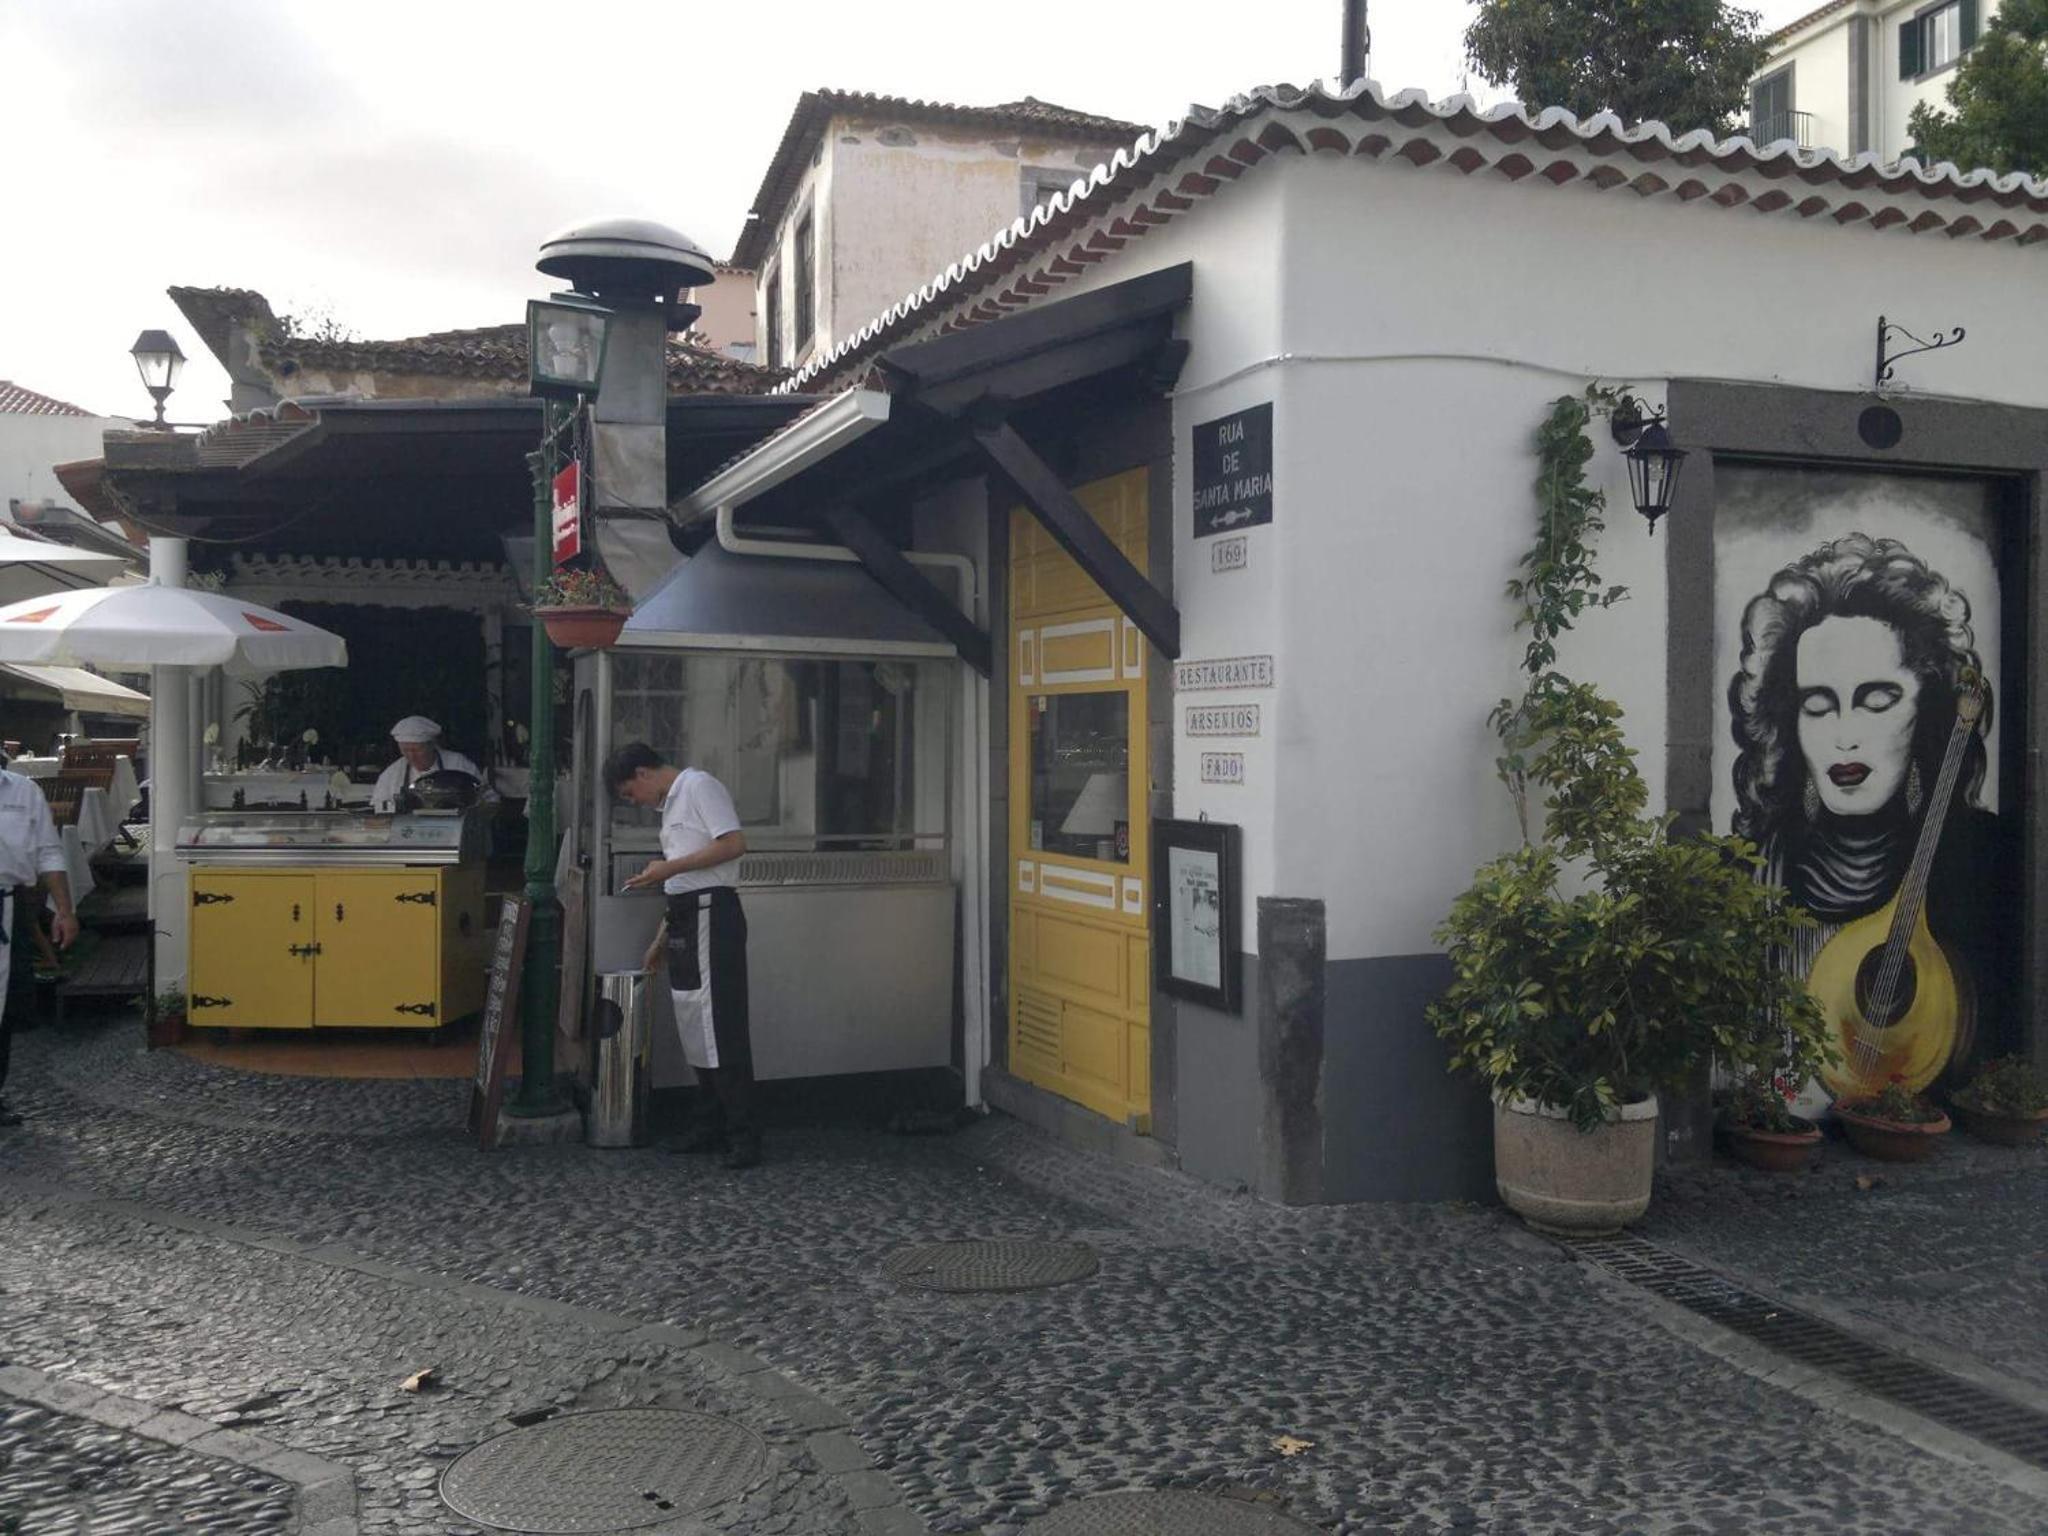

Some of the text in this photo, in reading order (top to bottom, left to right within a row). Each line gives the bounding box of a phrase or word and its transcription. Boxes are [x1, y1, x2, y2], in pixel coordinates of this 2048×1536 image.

[1219, 421, 1244, 445] RUA
[1223, 451, 1240, 474] DE
[1194, 473, 1272, 510] SANTA MARIA
[1217, 545, 1242, 564] 169
[1180, 663, 1266, 686] RESTAURANTE
[1189, 710, 1254, 731] ARSENIOS
[1206, 758, 1239, 777] FADO
